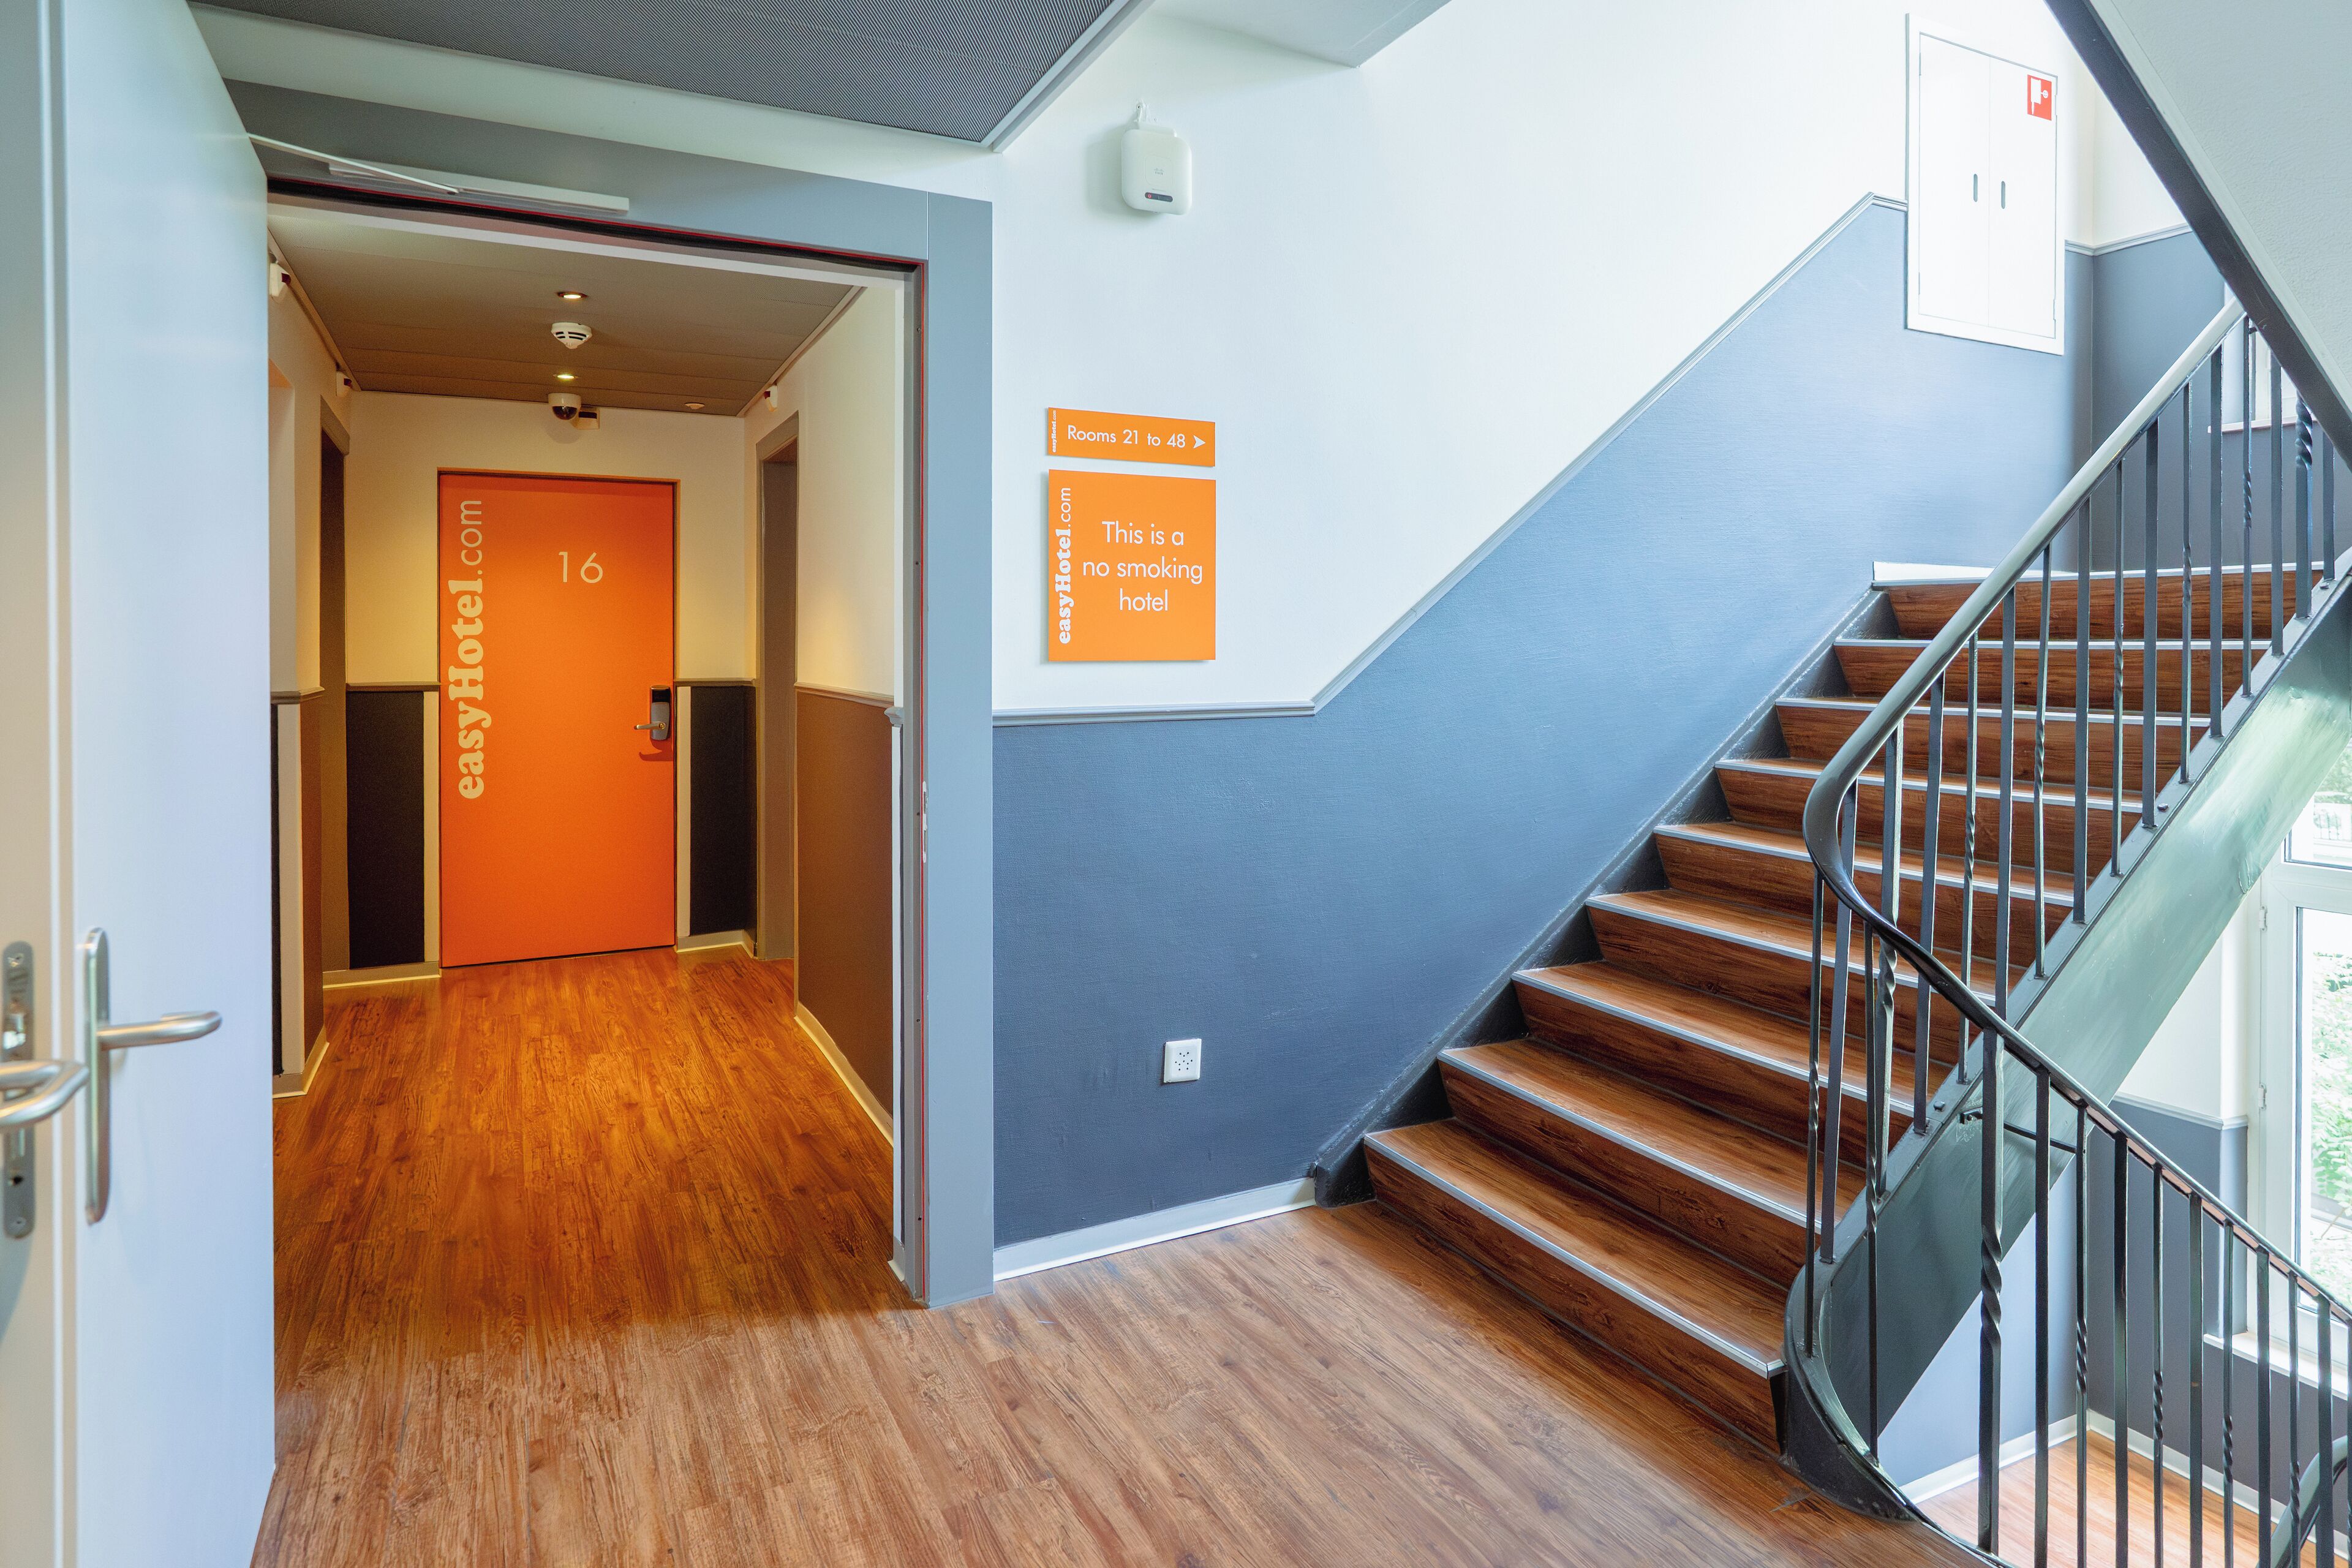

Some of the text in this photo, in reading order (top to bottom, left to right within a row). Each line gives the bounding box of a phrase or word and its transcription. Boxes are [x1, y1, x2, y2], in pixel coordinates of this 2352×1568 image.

[1068, 424, 1186, 448] Rooms 21 to 48
[1101, 520, 1184, 546] This is a
[559, 551, 603, 584] 16
[1055, 488, 1074, 644] easyHotel.com
[1083, 556, 1203, 585] no smoking
[1119, 587, 1168, 612] hotel
[448, 500, 492, 799] easyHotel.com
